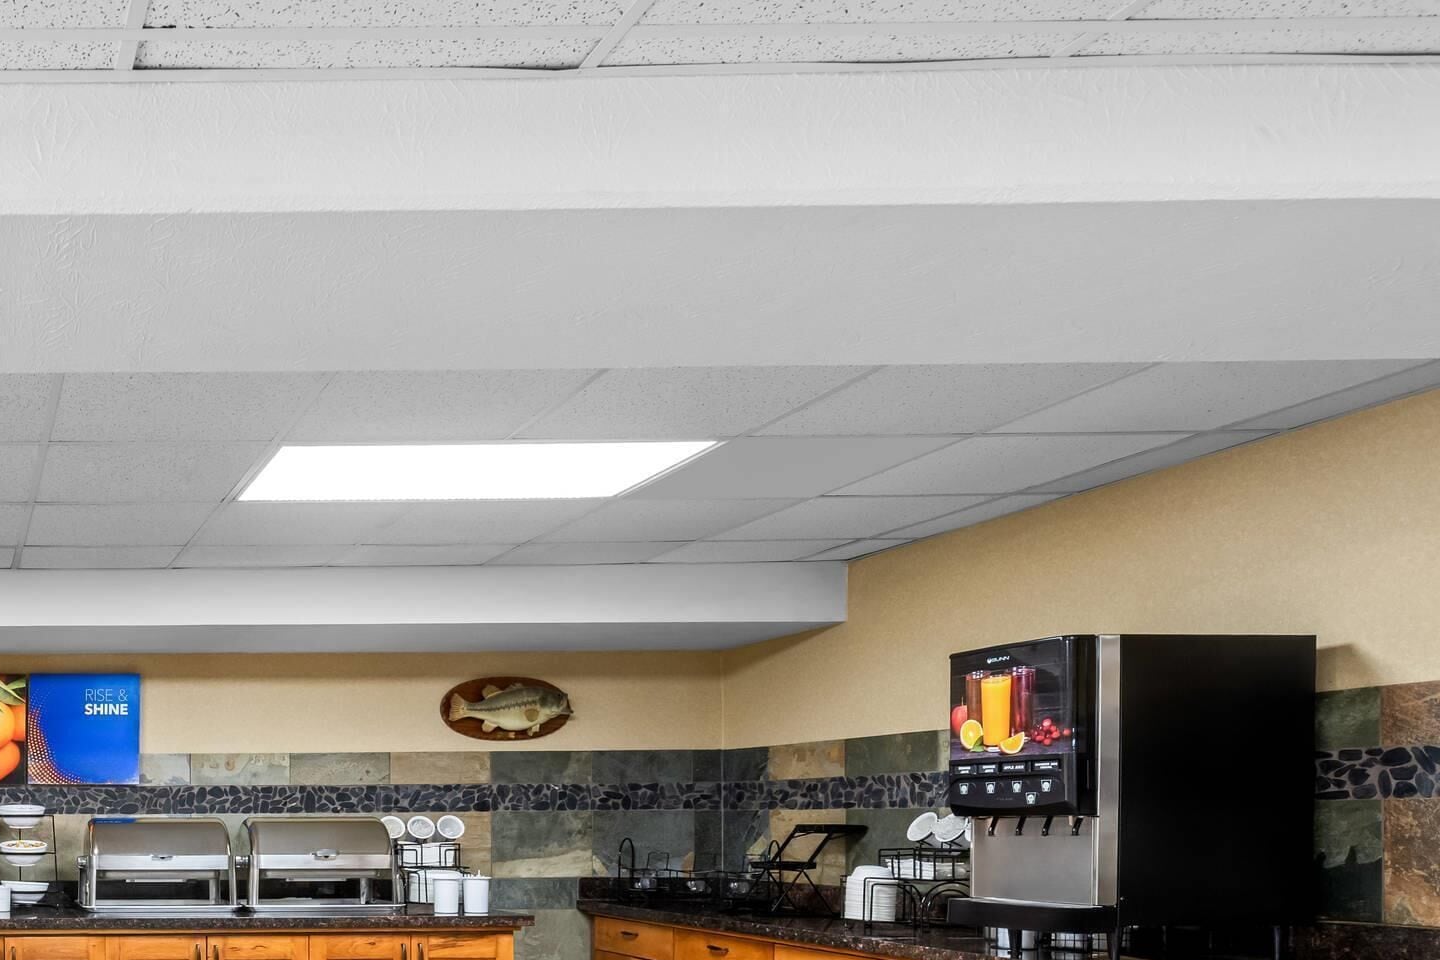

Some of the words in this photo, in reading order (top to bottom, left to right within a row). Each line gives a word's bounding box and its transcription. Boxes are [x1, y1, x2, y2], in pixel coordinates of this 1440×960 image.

[85, 688, 113, 702] RISE
[118, 688, 128, 702] &
[84, 703, 129, 716] SHINE
